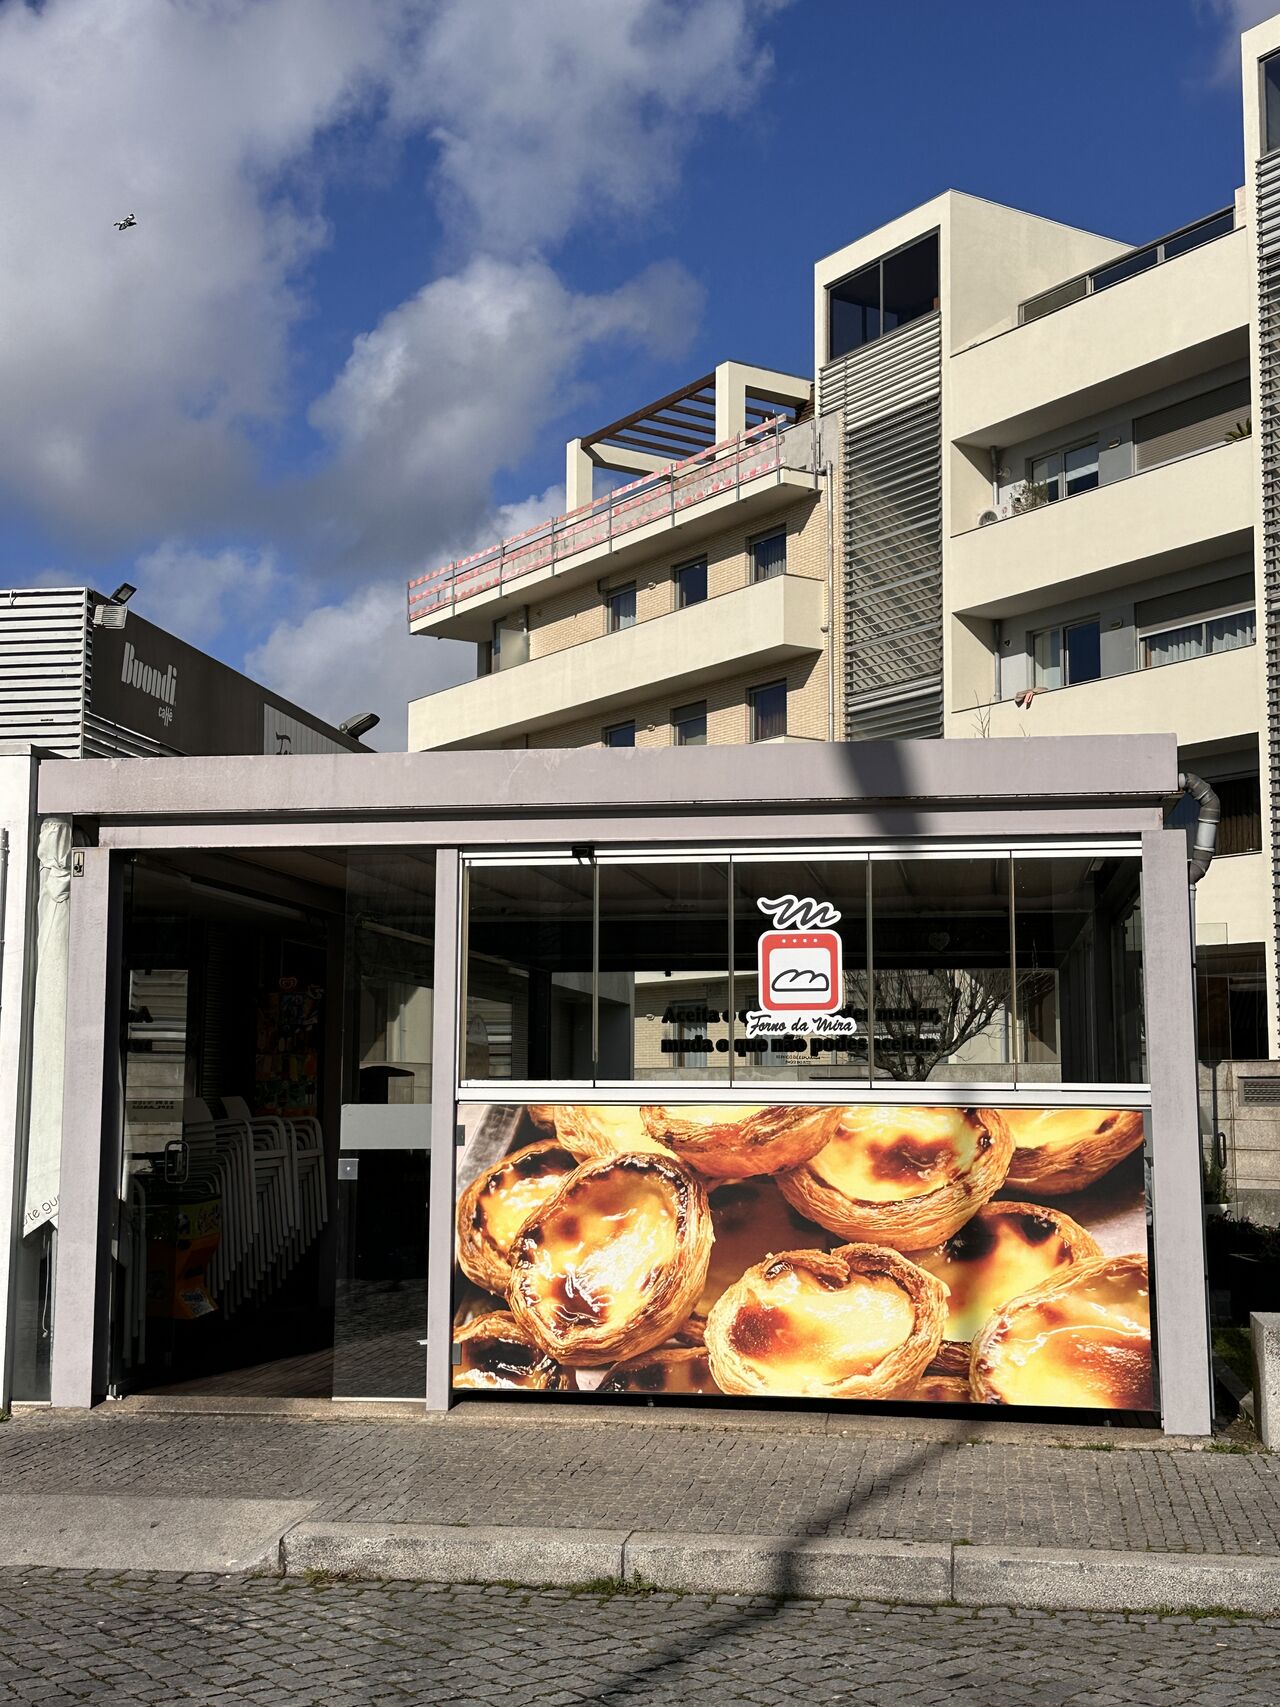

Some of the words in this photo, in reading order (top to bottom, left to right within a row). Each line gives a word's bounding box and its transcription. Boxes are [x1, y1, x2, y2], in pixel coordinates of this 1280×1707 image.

[662, 1006, 720, 1023] Aceita
[749, 1014, 787, 1035] Forno
[791, 1017, 809, 1032] da
[812, 1017, 853, 1032] Mira
[661, 1034, 714, 1053] muda
[715, 1039, 729, 1053] o
[733, 1038, 769, 1058] que
[770, 1034, 806, 1053] não
[810, 1035, 869, 1057] podes
